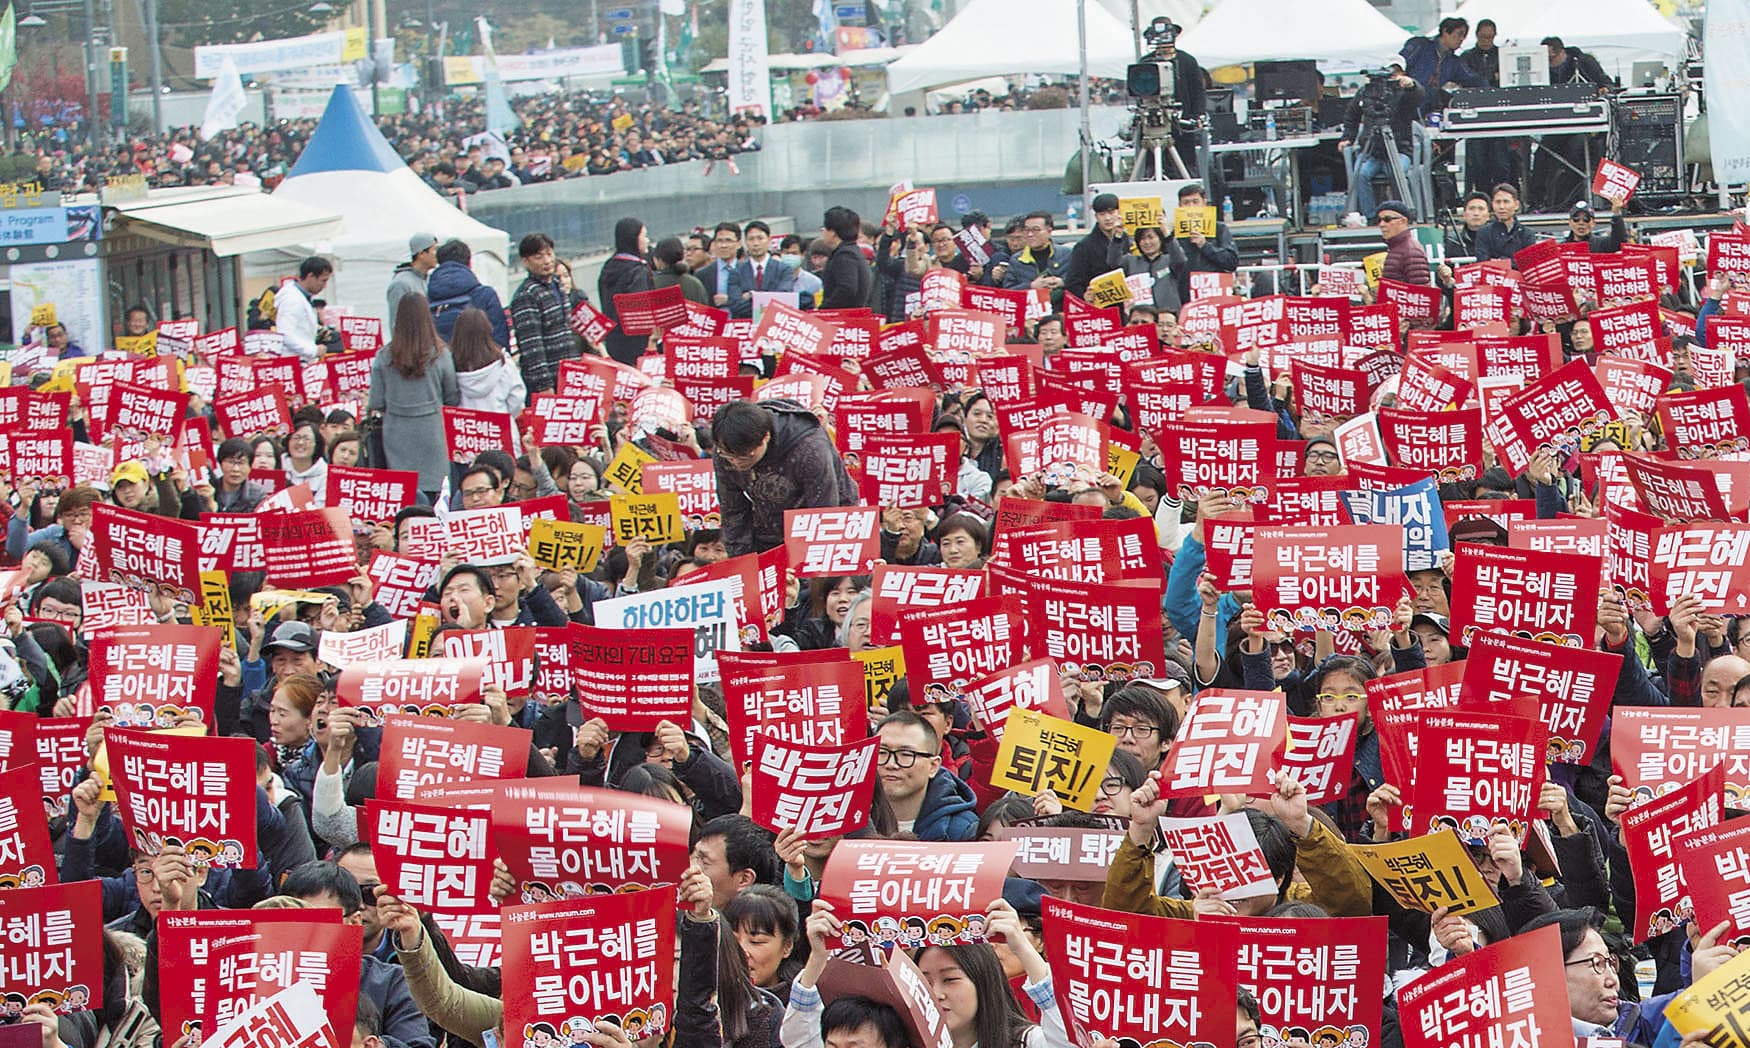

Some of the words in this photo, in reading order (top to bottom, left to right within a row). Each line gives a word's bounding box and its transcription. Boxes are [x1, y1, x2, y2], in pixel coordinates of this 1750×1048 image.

[1518, 380, 1583, 419] 박근혜는
[1394, 421, 1467, 446] 박근혜를
[1531, 398, 1594, 439] 하야하라
[1179, 436, 1259, 461] 박근혜를
[1397, 442, 1467, 465] 몰아내자
[1180, 458, 1259, 484] 몰아내자
[108, 524, 184, 563] 박근혜를
[619, 515, 673, 543] 퇴진!
[791, 512, 873, 541] 박근혜
[111, 548, 185, 585] 몰아내자
[802, 545, 863, 573] 퇴진
[1276, 544, 1380, 573] 박근혜를
[1276, 576, 1380, 603] 몰아내자
[1476, 566, 1577, 599] 박근혜를
[1046, 599, 1139, 632] 박근혜를
[1473, 598, 1574, 630] 몰아내자
[106, 643, 198, 673] 박근혜를
[1046, 631, 1139, 659] 몰아내자
[103, 674, 195, 703] 몰아내자
[1040, 729, 1081, 755] 박근혜
[1446, 738, 1536, 775] 박근혜를
[124, 755, 230, 796] 박근혜를
[759, 744, 877, 790] 박근혜
[1005, 744, 1095, 803] 퇴진!
[1171, 743, 1260, 789] 퇴진
[772, 791, 848, 830] 퇴진
[1443, 776, 1532, 814] 몰아내자
[130, 794, 229, 835] 몰아내자
[857, 850, 984, 875] 박근혜를
[849, 879, 975, 913] 몰아내자
[530, 918, 659, 969] 박근혜를
[1065, 933, 1203, 990] 박근혜를
[532, 961, 658, 1016] 몰아내자
[1420, 966, 1536, 1041] 박근혜를
[1068, 984, 1202, 1036] 몰아내자
